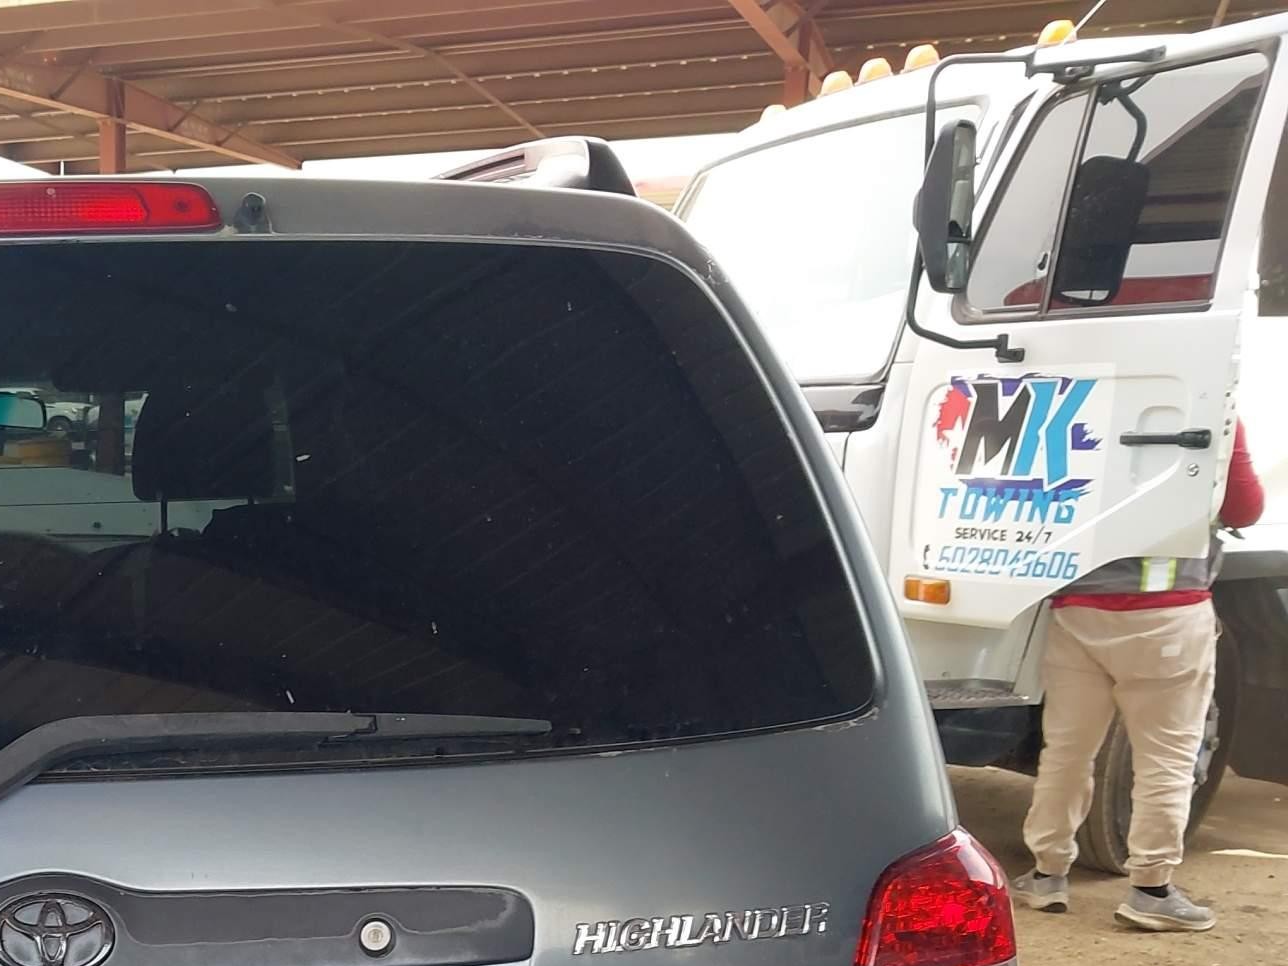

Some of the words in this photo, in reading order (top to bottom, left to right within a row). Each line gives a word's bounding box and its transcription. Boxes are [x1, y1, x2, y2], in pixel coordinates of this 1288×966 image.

[955, 379, 1098, 488] MK
[937, 486, 1085, 524] TOWING
[954, 527, 1008, 542] SERVICE
[1015, 527, 1053, 545] 24/7
[572, 902, 830, 956] HIGHLANDER
